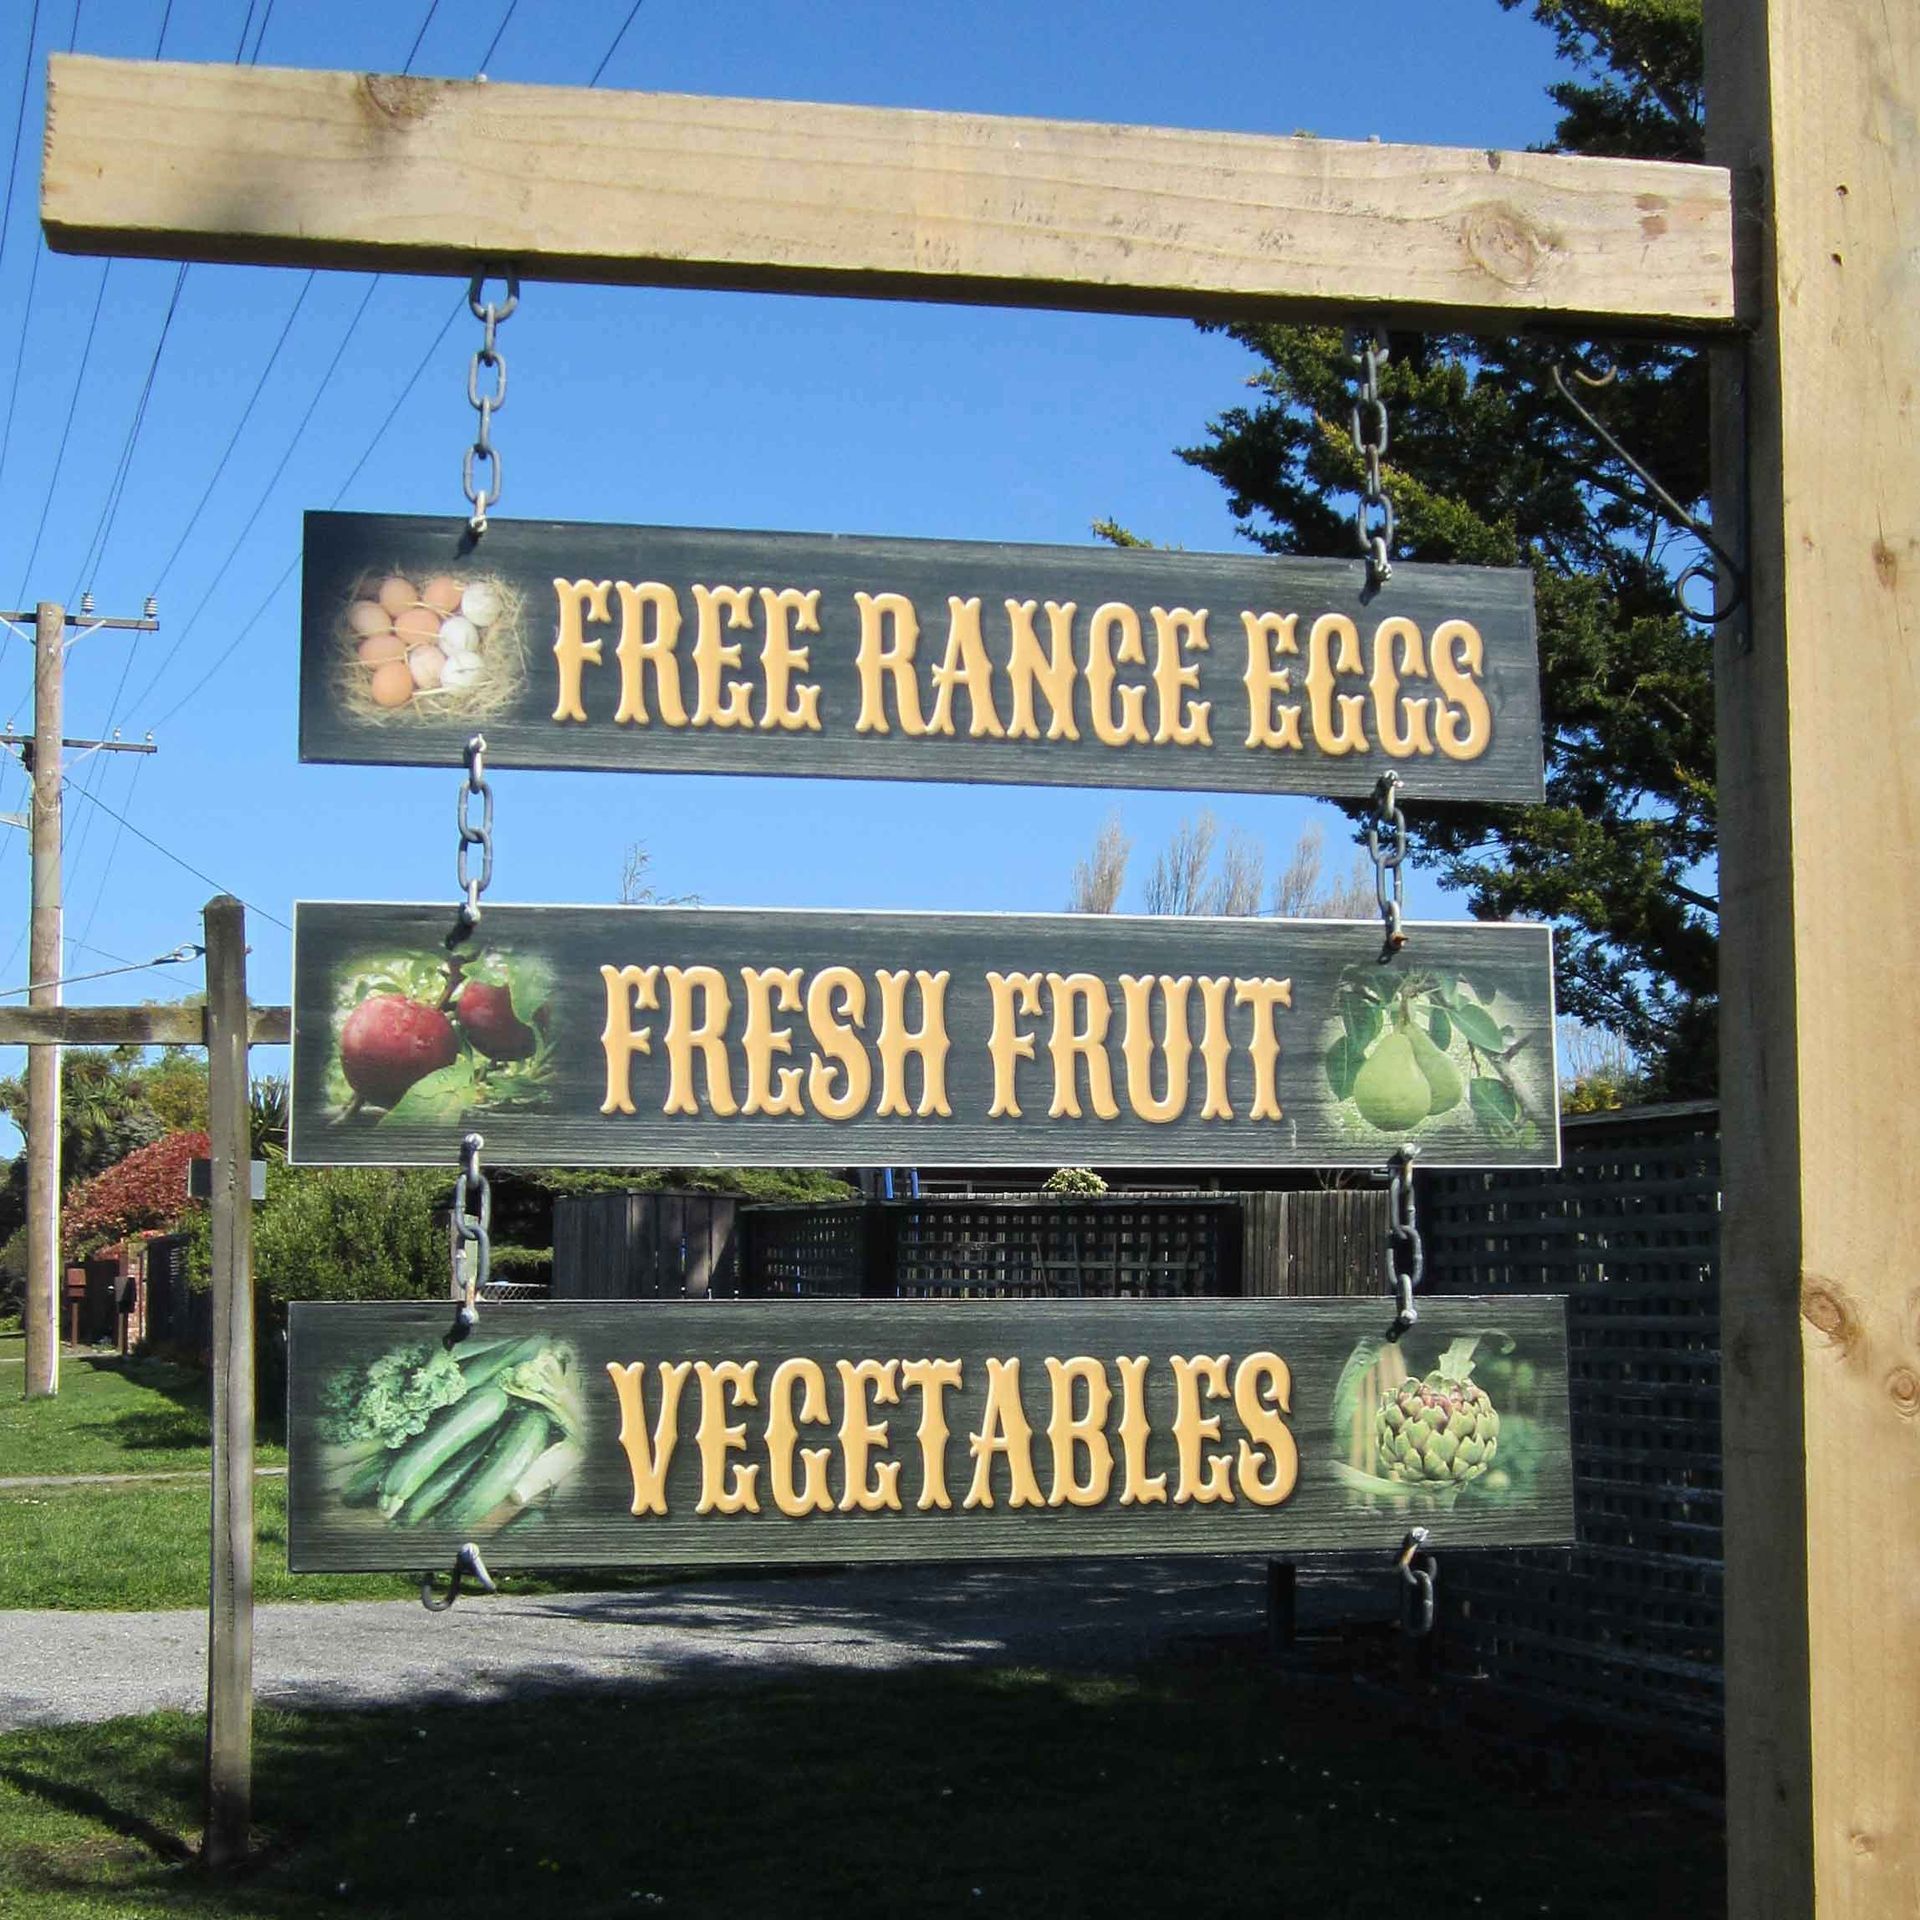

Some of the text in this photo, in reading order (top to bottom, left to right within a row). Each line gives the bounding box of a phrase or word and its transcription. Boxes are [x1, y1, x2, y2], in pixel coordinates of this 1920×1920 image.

[553, 578, 1491, 761] FREE RANGE EGGS
[600, 965, 1292, 1124] FRESH FRUIT
[607, 1352, 1298, 1517] VEGETABLES
